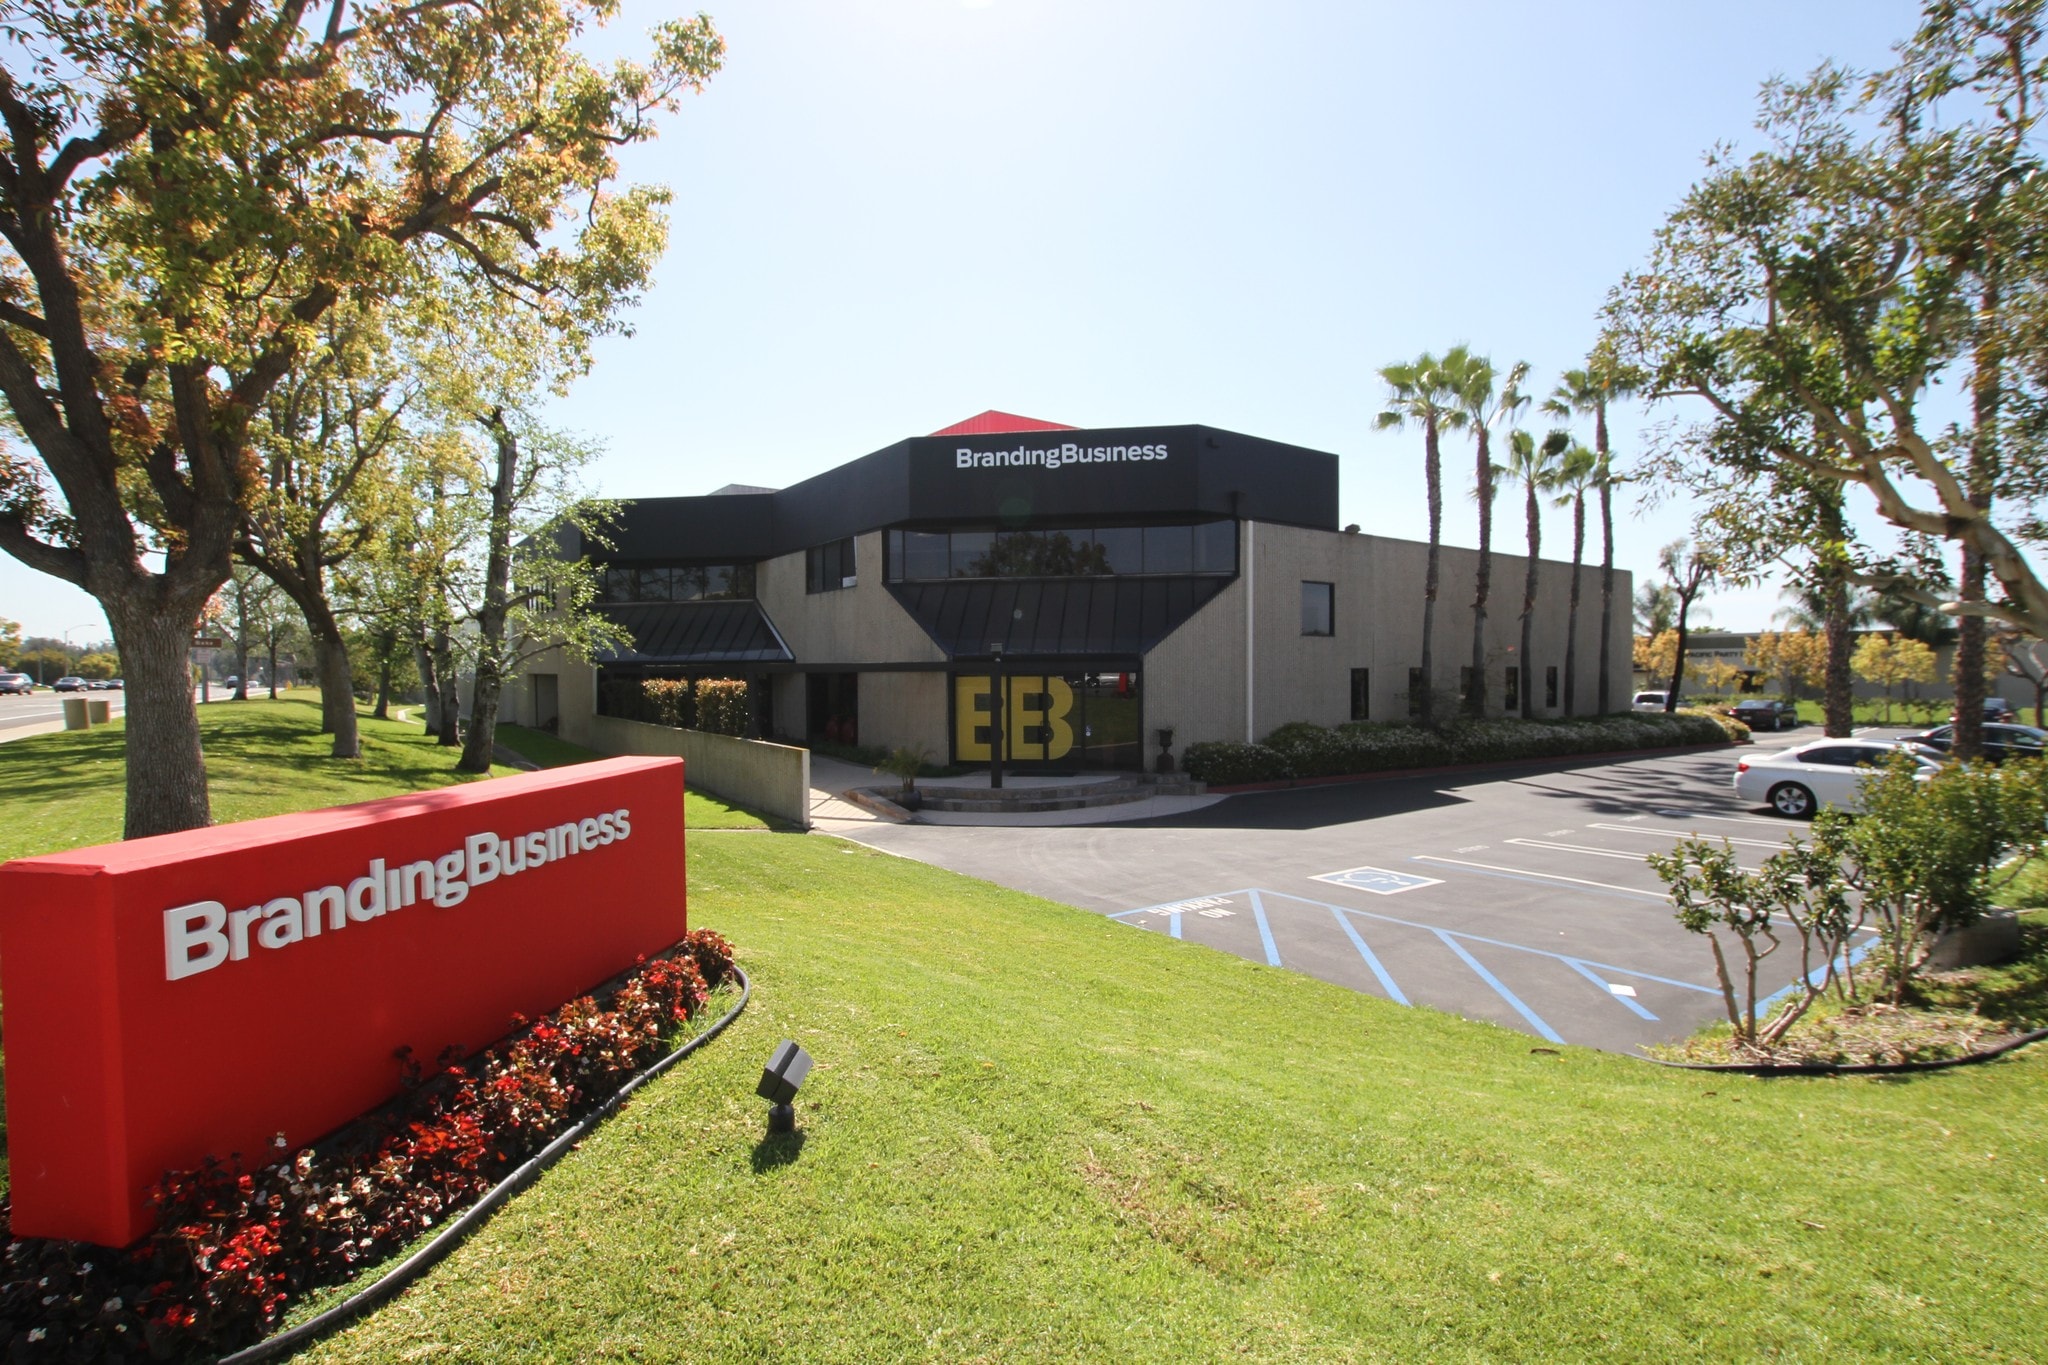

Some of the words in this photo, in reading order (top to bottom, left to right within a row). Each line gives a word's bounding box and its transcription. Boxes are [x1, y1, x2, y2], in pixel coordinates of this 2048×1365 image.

[956, 443, 1168, 468] BrandingBusiness
[164, 808, 631, 981] BrandingBusiness
[1147, 896, 1234, 916] PARKING
[1198, 907, 1237, 919] NO
